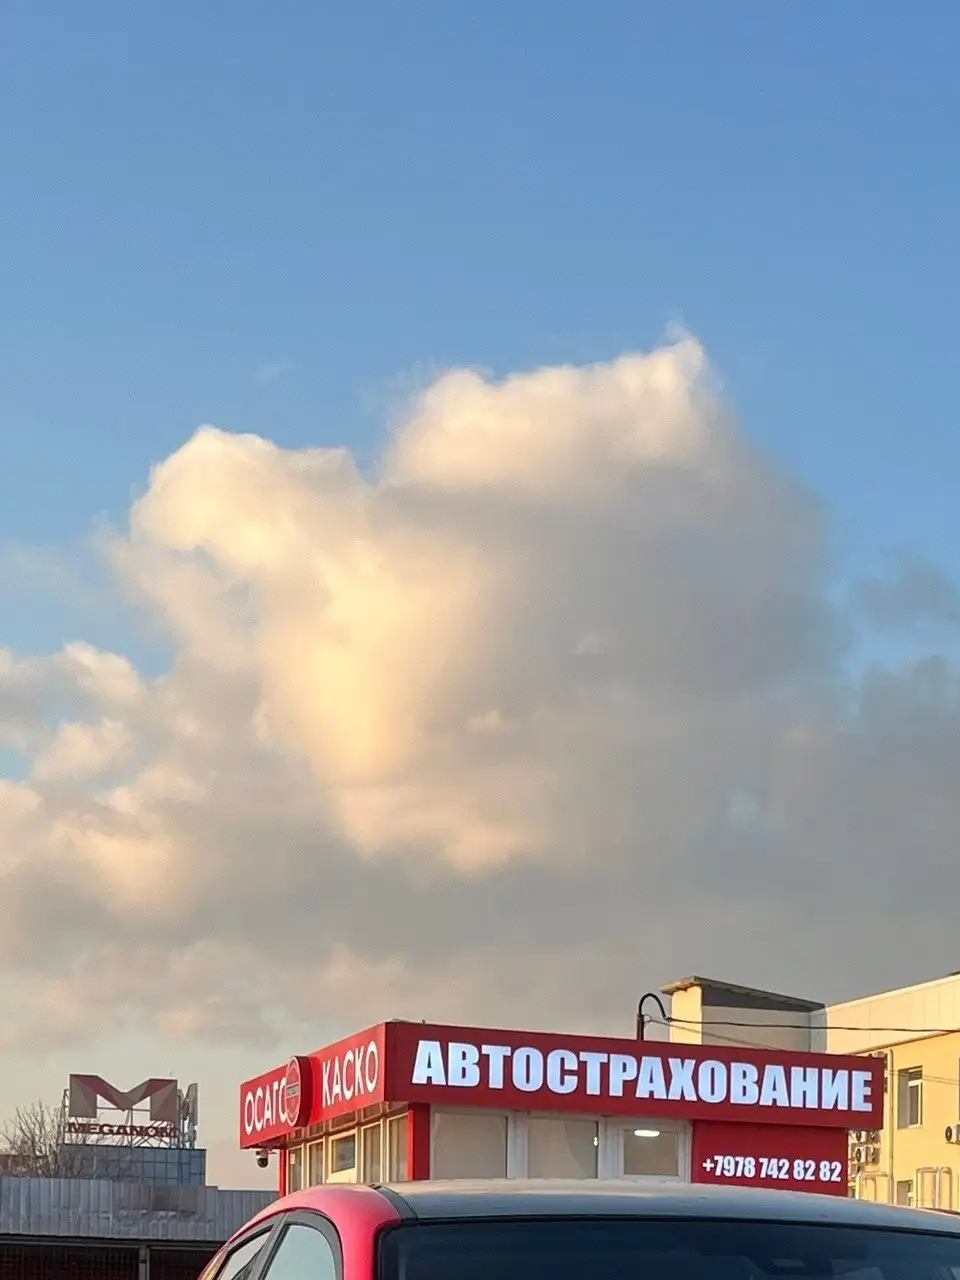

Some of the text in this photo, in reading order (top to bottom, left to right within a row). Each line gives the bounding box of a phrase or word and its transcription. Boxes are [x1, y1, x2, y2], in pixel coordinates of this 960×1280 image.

[322, 1040, 379, 1109] КАСКО
[411, 1038, 874, 1113] АВТОСТРАХОВАНИЕ
[702, 1155, 842, 1182] +7978 742 82 82
